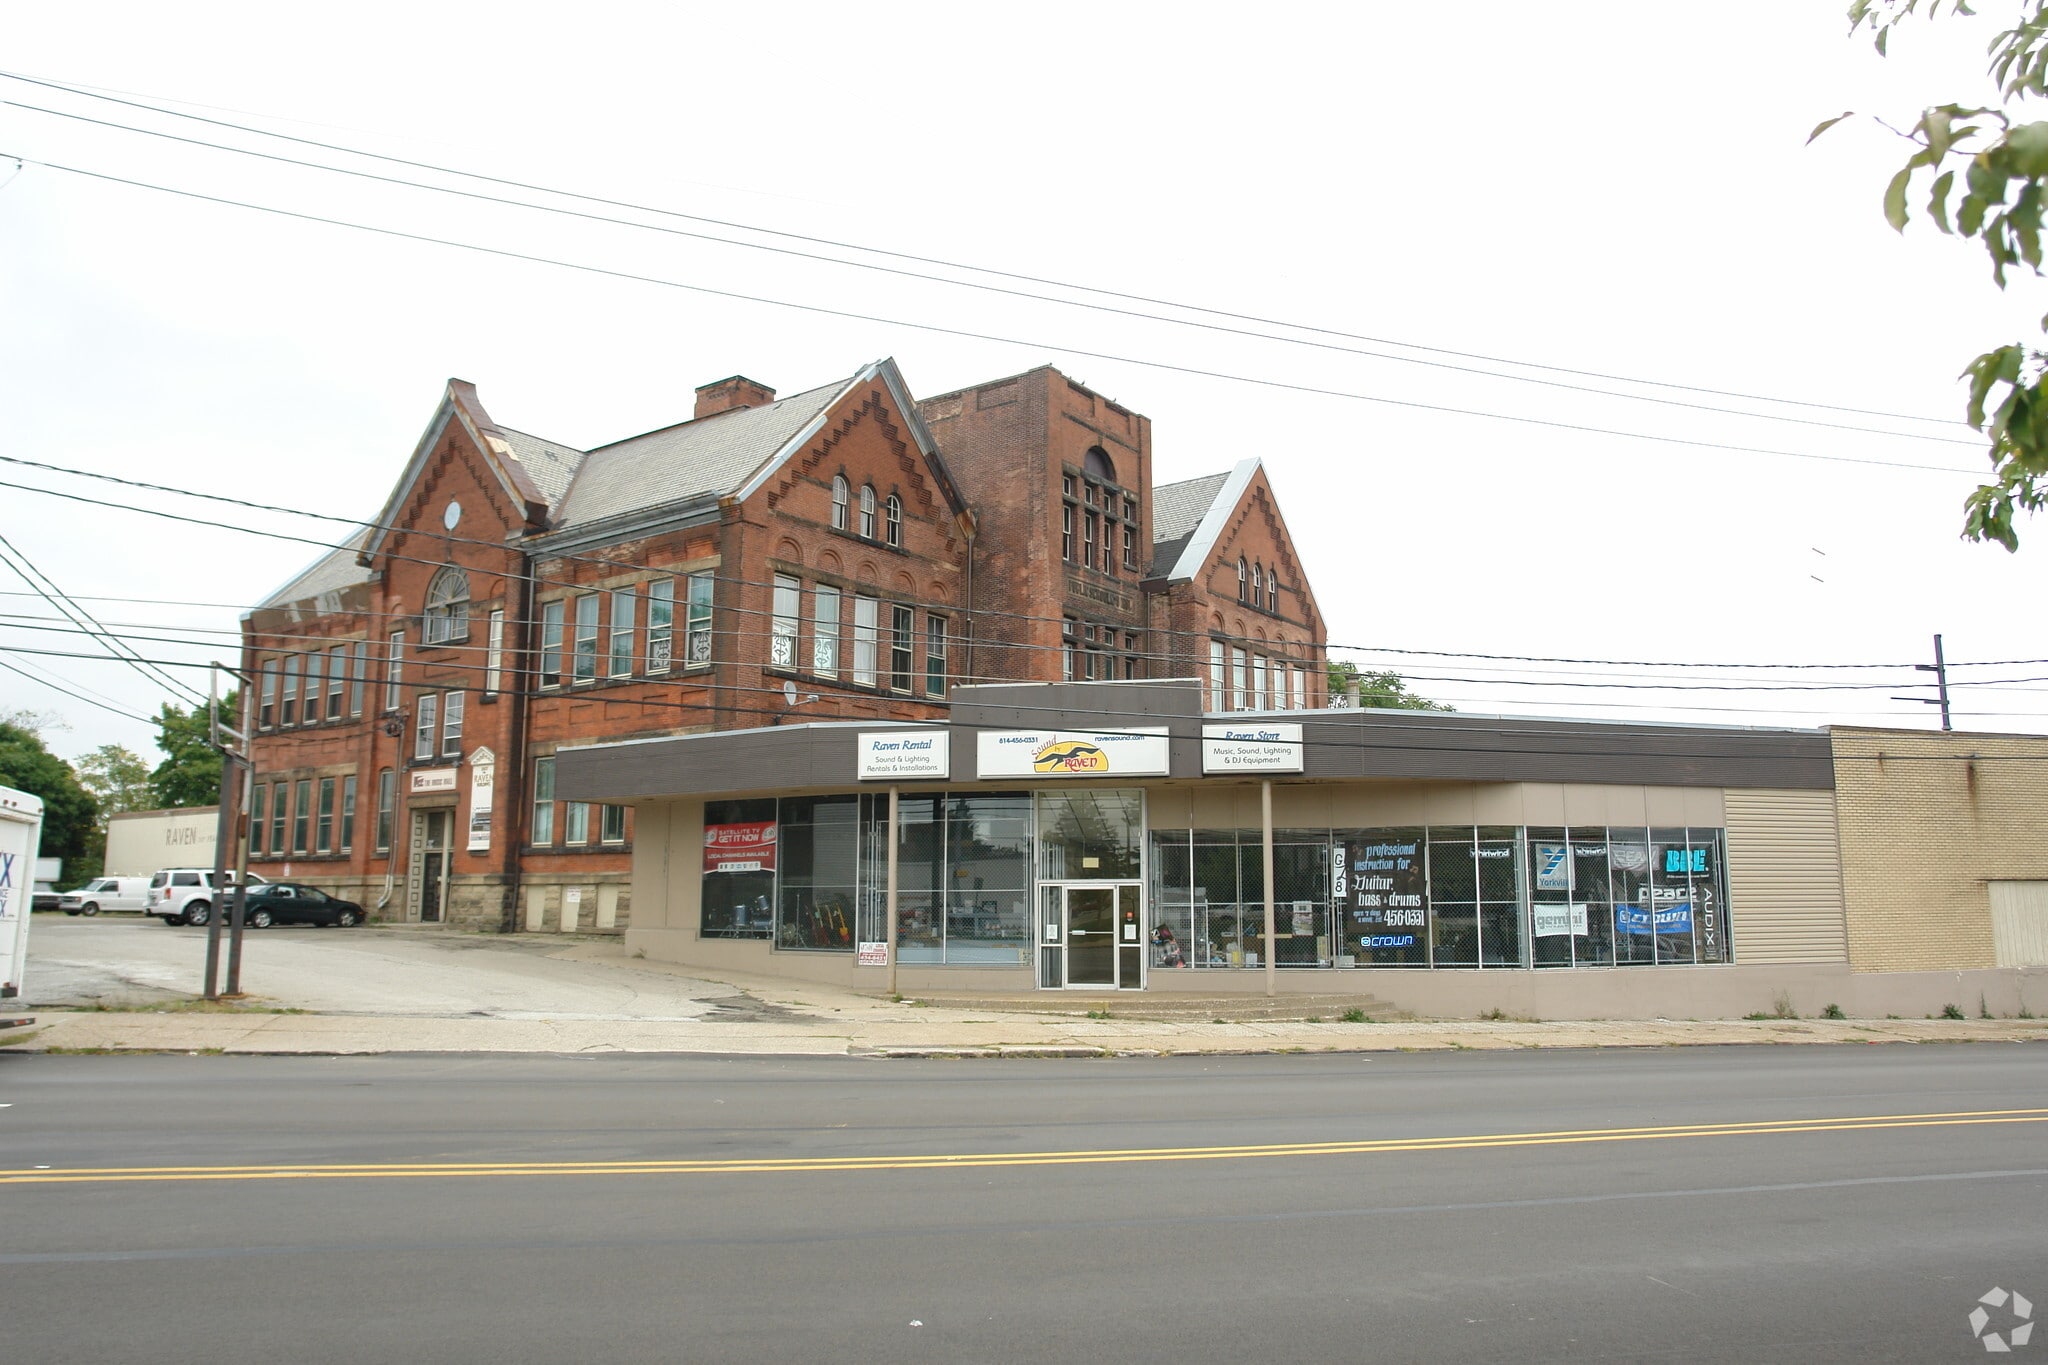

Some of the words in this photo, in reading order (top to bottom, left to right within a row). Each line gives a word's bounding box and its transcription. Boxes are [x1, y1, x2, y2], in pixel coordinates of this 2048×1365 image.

[1225, 731, 1254, 740] Raven
[1257, 730, 1281, 741] Store
[872, 741, 900, 751] Raven
[902, 739, 933, 750] Rental
[1237, 747, 1262, 755] Sound,
[1264, 747, 1292, 755] Lighting
[904, 755, 930, 763] Lighting
[1063, 757, 1098, 772] RAVEN
[1243, 757, 1281, 765] Equipment
[166, 826, 197, 846] RAVEN
[718, 835, 732, 843] GET
[733, 834, 741, 842] IT
[742, 833, 760, 842] NOW
[1366, 843, 1417, 859] professional
[1354, 859, 1394, 871] instruction
[1397, 857, 1410, 871] for
[1358, 892, 1381, 907] bass
[1389, 891, 1421, 907] drums
[1704, 888, 1715, 945] AUDIX
